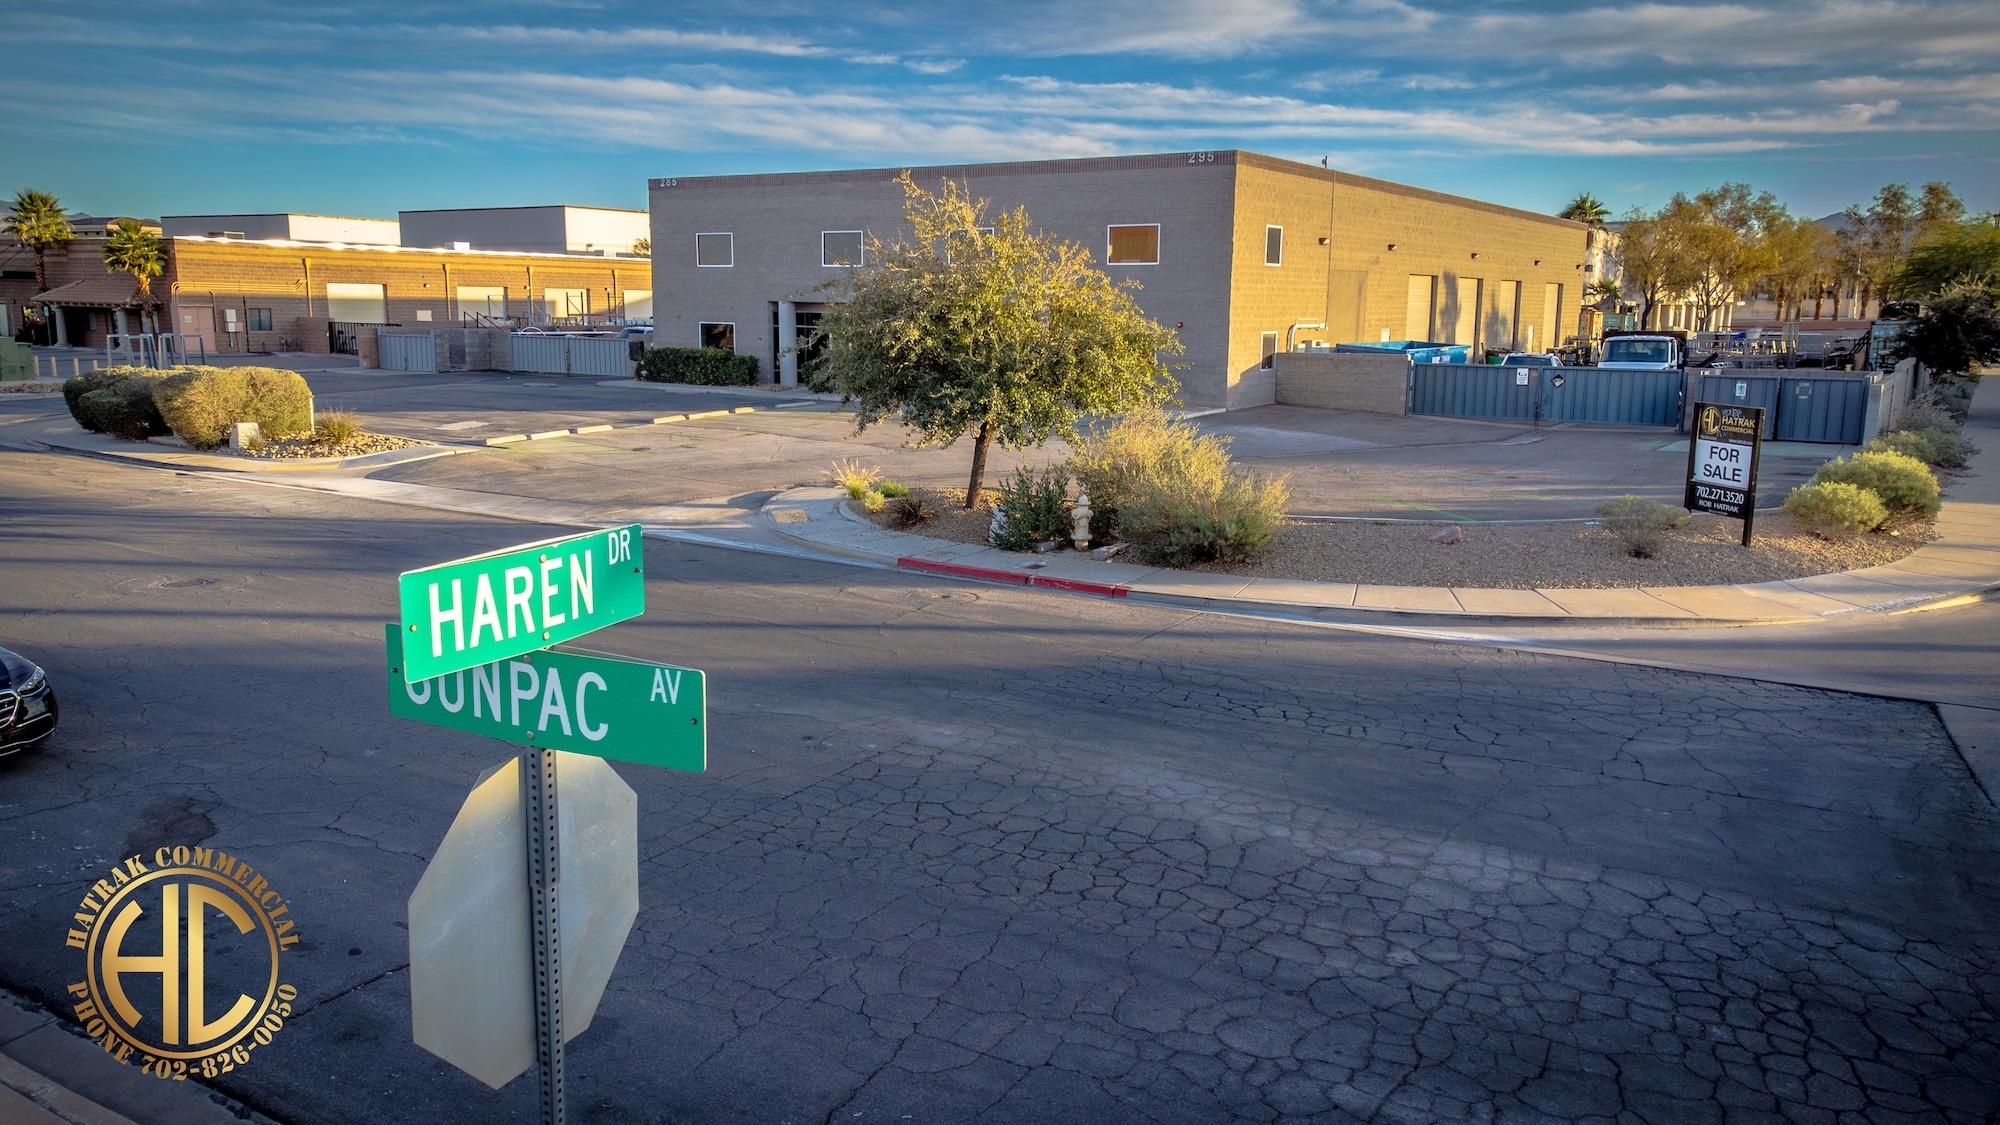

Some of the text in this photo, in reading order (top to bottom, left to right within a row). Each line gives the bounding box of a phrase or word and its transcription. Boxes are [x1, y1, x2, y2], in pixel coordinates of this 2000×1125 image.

[1188, 152, 1215, 163] 295
[660, 178, 677, 187] 285
[1721, 416, 1756, 428] HATRAK
[1709, 445, 1740, 464] FOR
[1703, 463, 1742, 483] SALE
[1696, 485, 1745, 505] 702.271.3520
[1698, 500, 1712, 508] ROB
[1713, 502, 1739, 513] HATRAK
[428, 529, 631, 658] HAREN DR
[650, 667, 682, 705] AV
